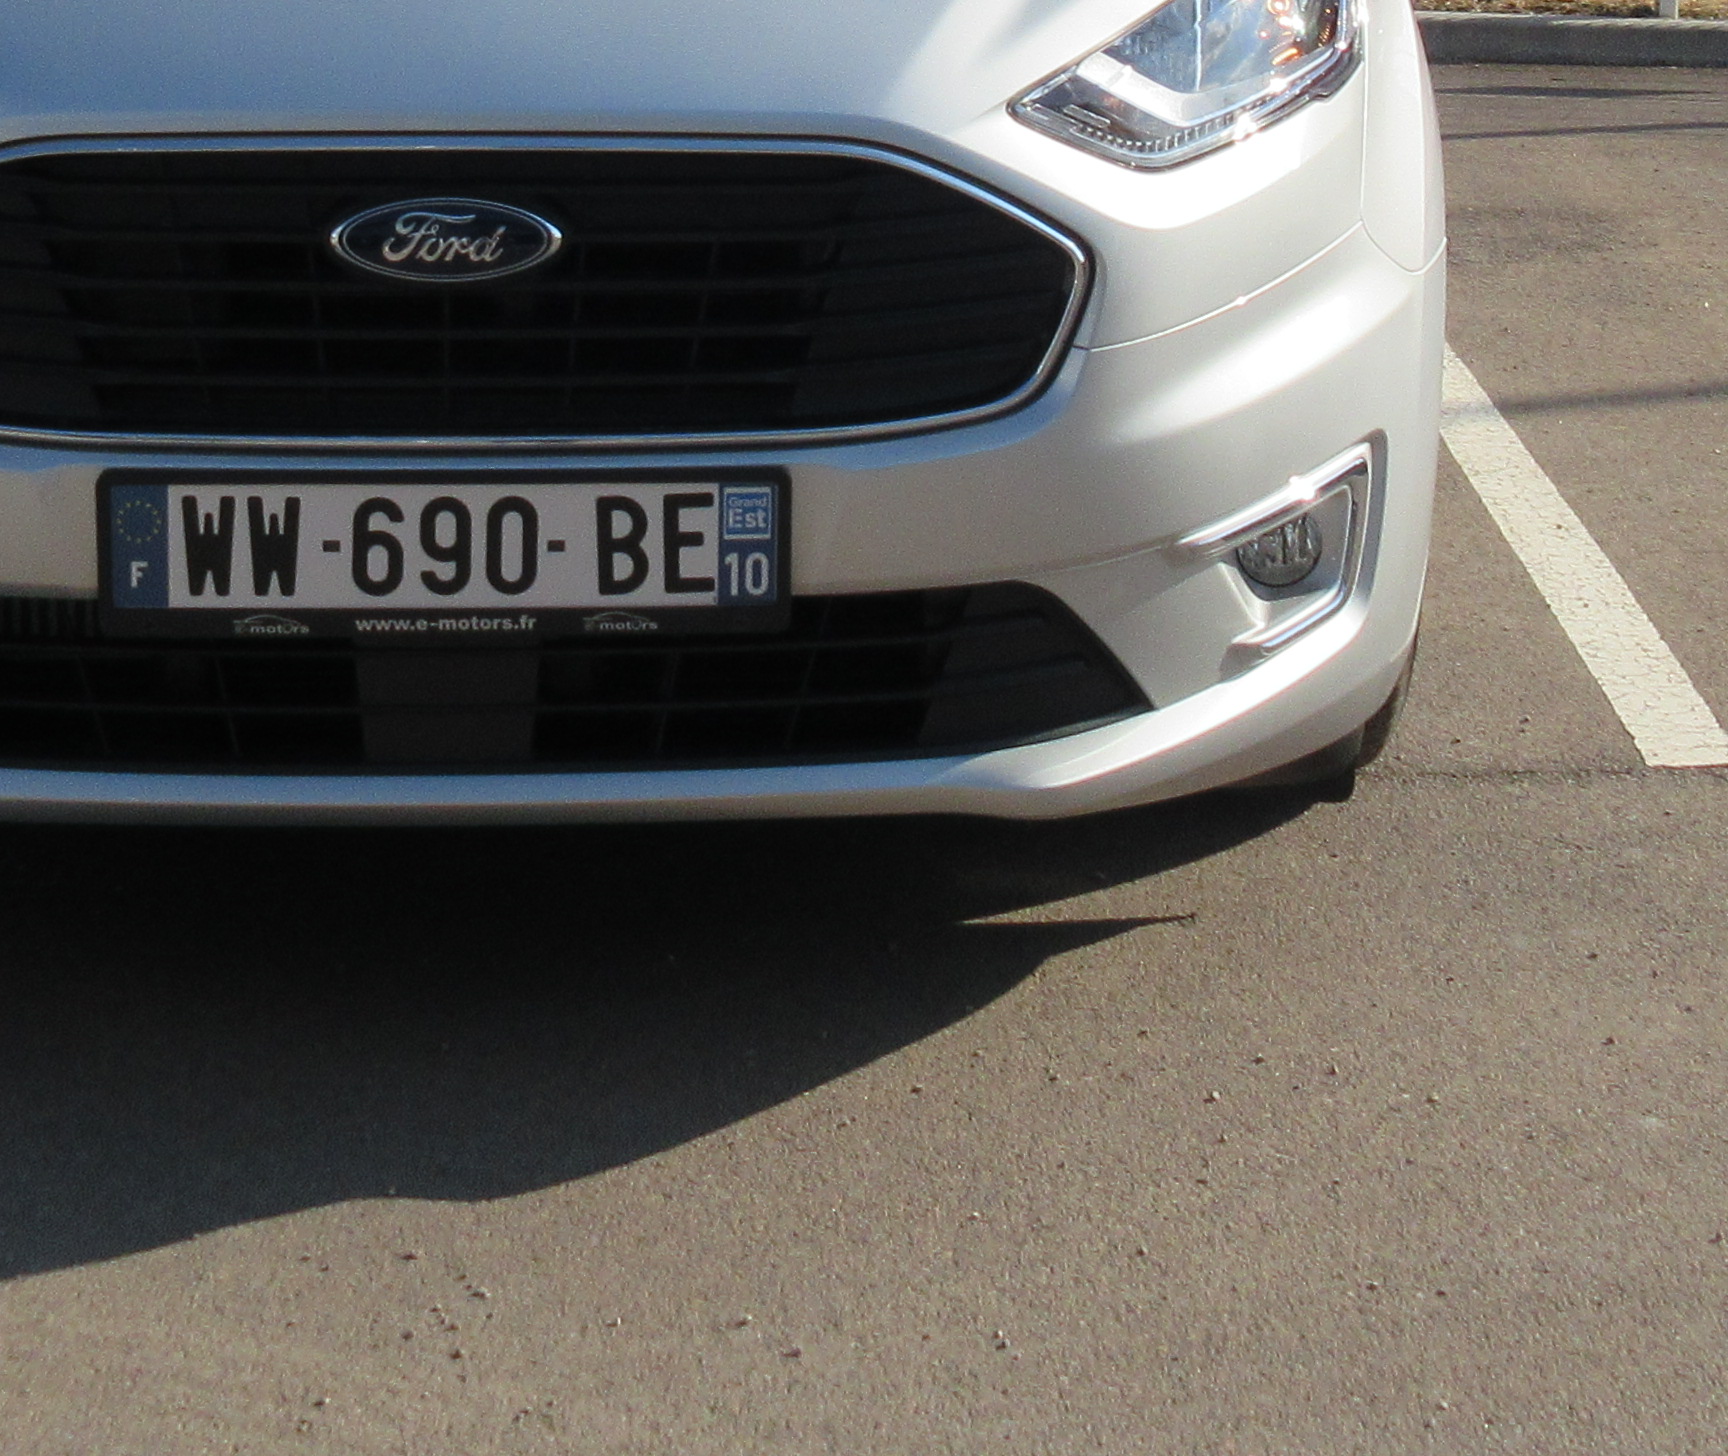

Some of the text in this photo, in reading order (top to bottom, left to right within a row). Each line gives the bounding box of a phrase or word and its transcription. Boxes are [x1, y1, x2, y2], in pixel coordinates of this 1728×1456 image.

[382, 211, 507, 262] Ford
[729, 496, 768, 507] Grand
[729, 508, 767, 528] Est
[181, 492, 715, 597] WW-690-BE
[130, 561, 148, 589] F
[724, 552, 769, 596] 10
[355, 615, 537, 631] www.e-motors.fr
